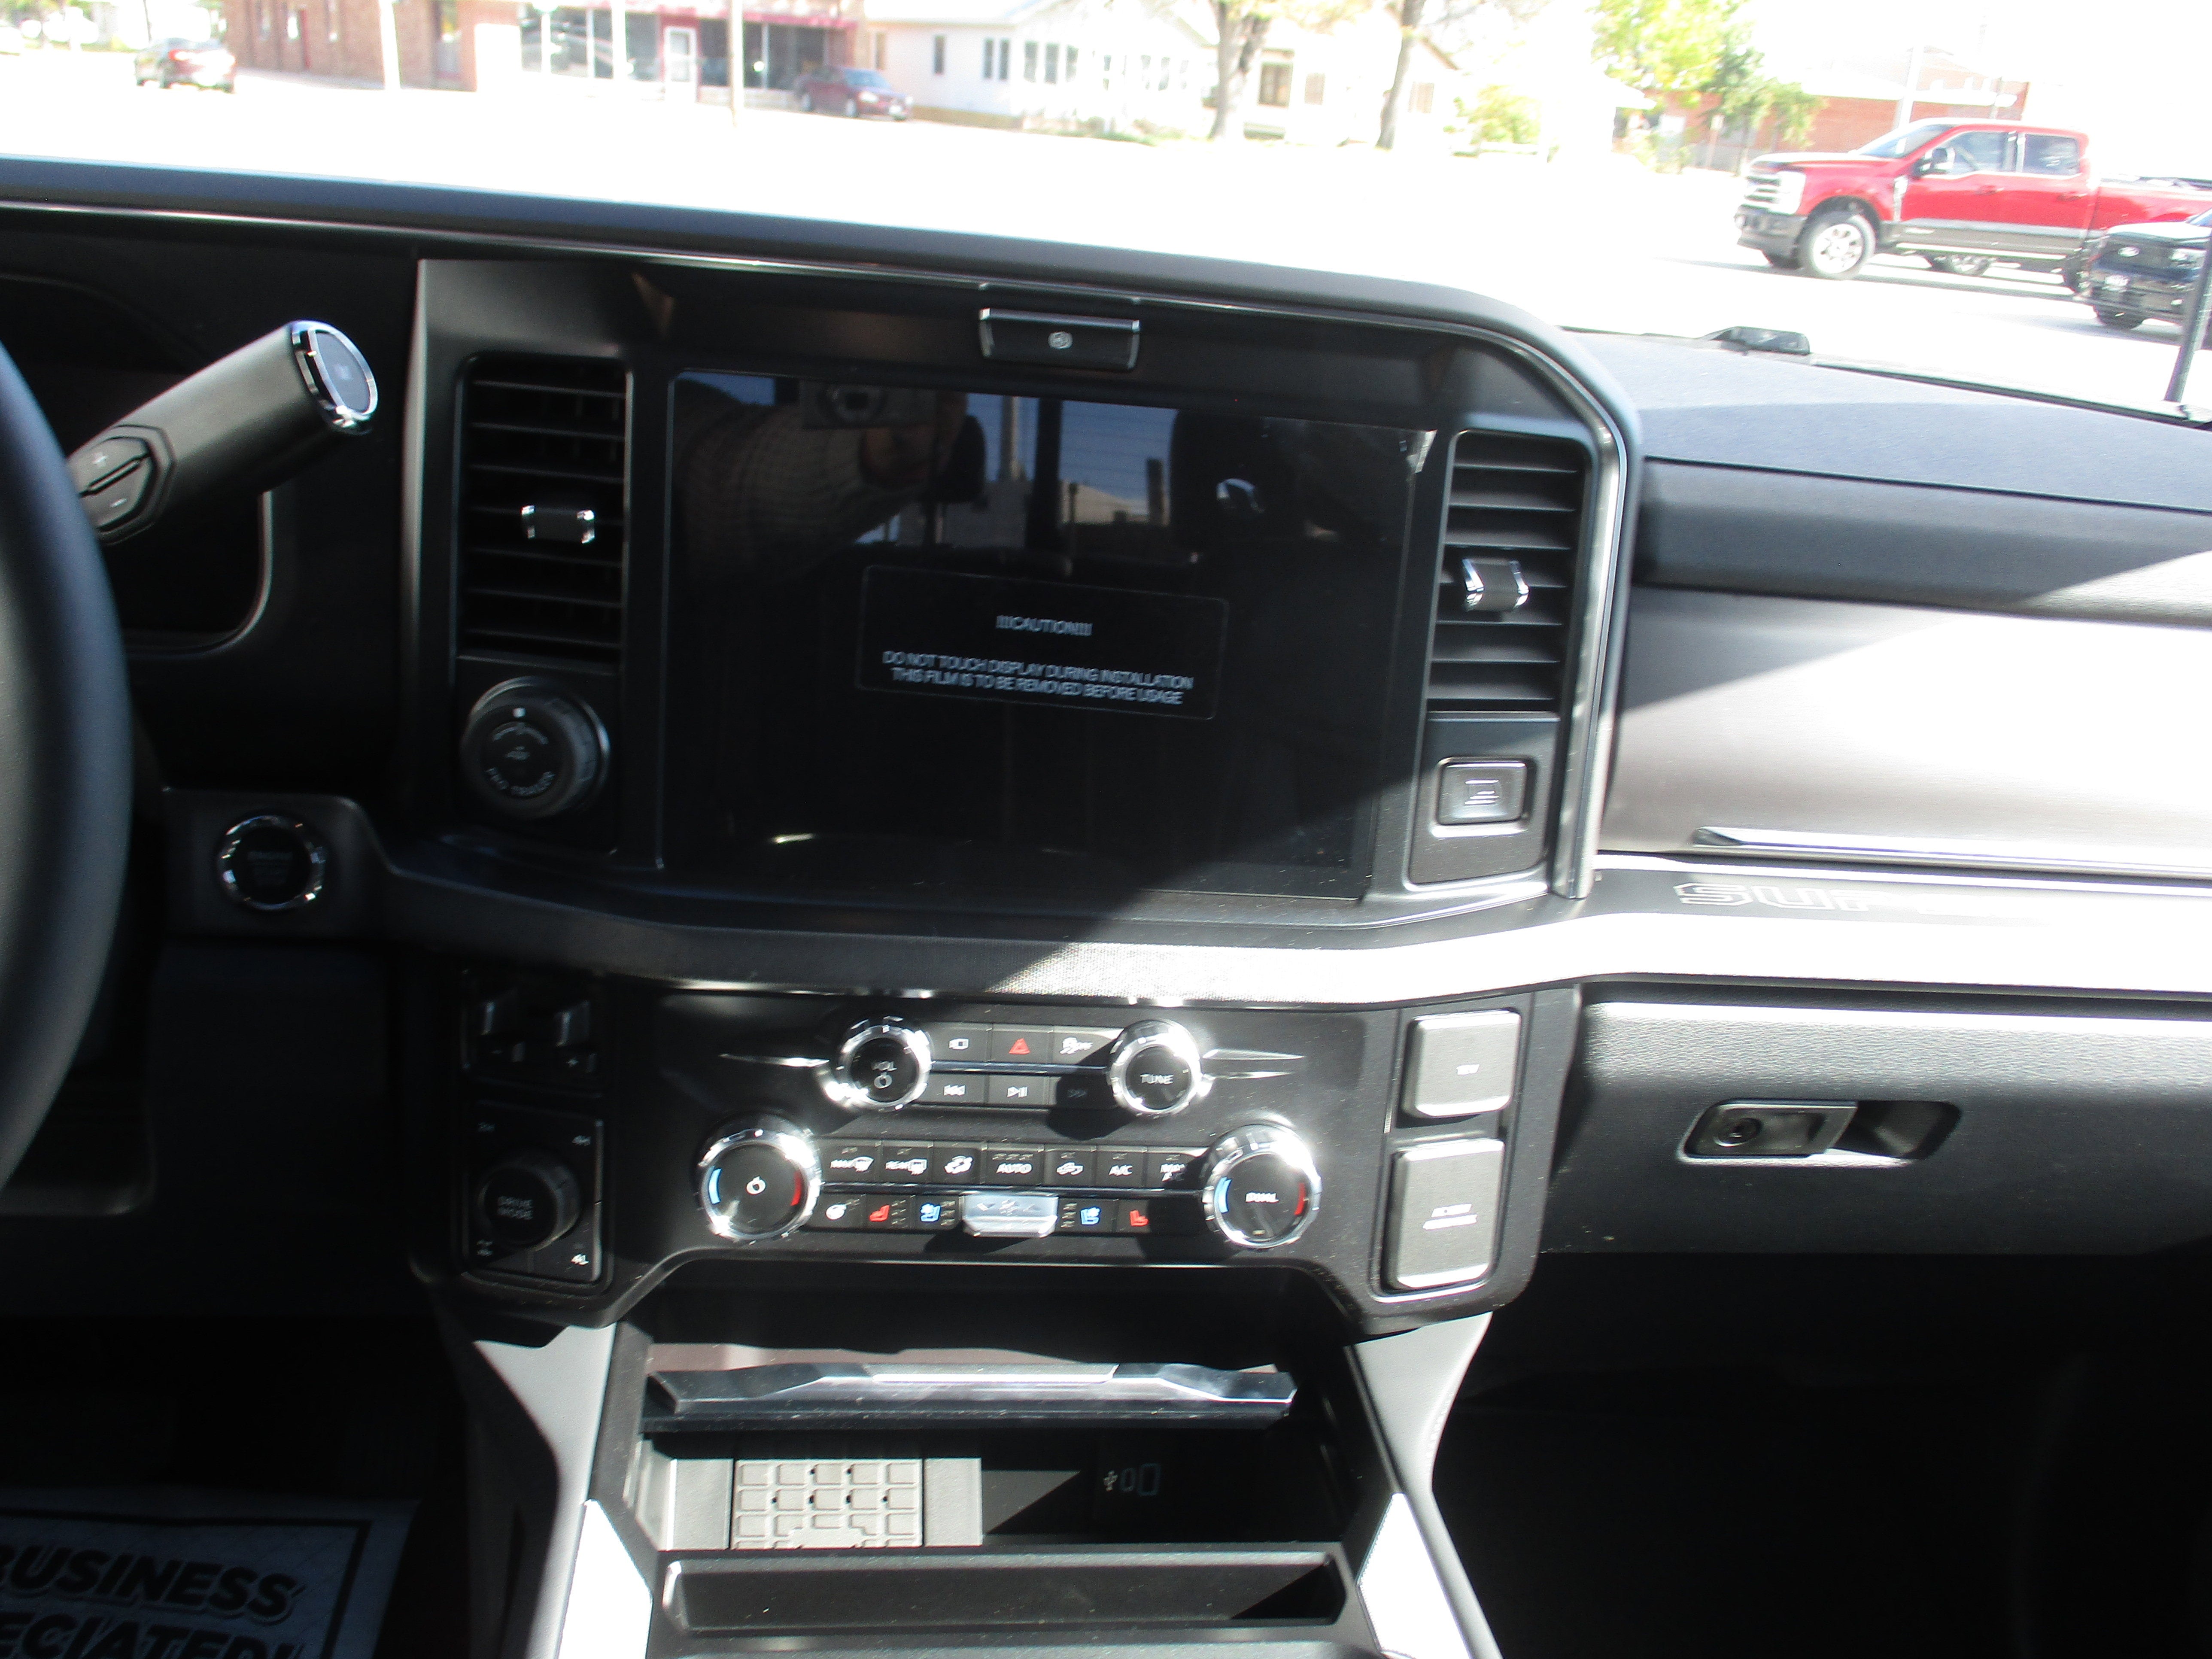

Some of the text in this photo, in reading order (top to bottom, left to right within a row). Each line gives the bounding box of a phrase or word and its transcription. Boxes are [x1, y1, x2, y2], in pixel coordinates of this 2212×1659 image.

[882, 650, 1194, 690] DO NOT TOUCH DISPLAY DURING INSTALLATION
[890, 666, 1184, 705] THIS FILM IS TO BE REMOVED BEFORE USAGE
[1139, 1074, 1174, 1085] TUNE
[996, 1163, 1033, 1175] AUTO
[1109, 1164, 1133, 1177] A/C
[1245, 1192, 1279, 1203] DUAL
[0, 1544, 298, 1617] USINESS
[0, 1611, 301, 1659] CIATE
